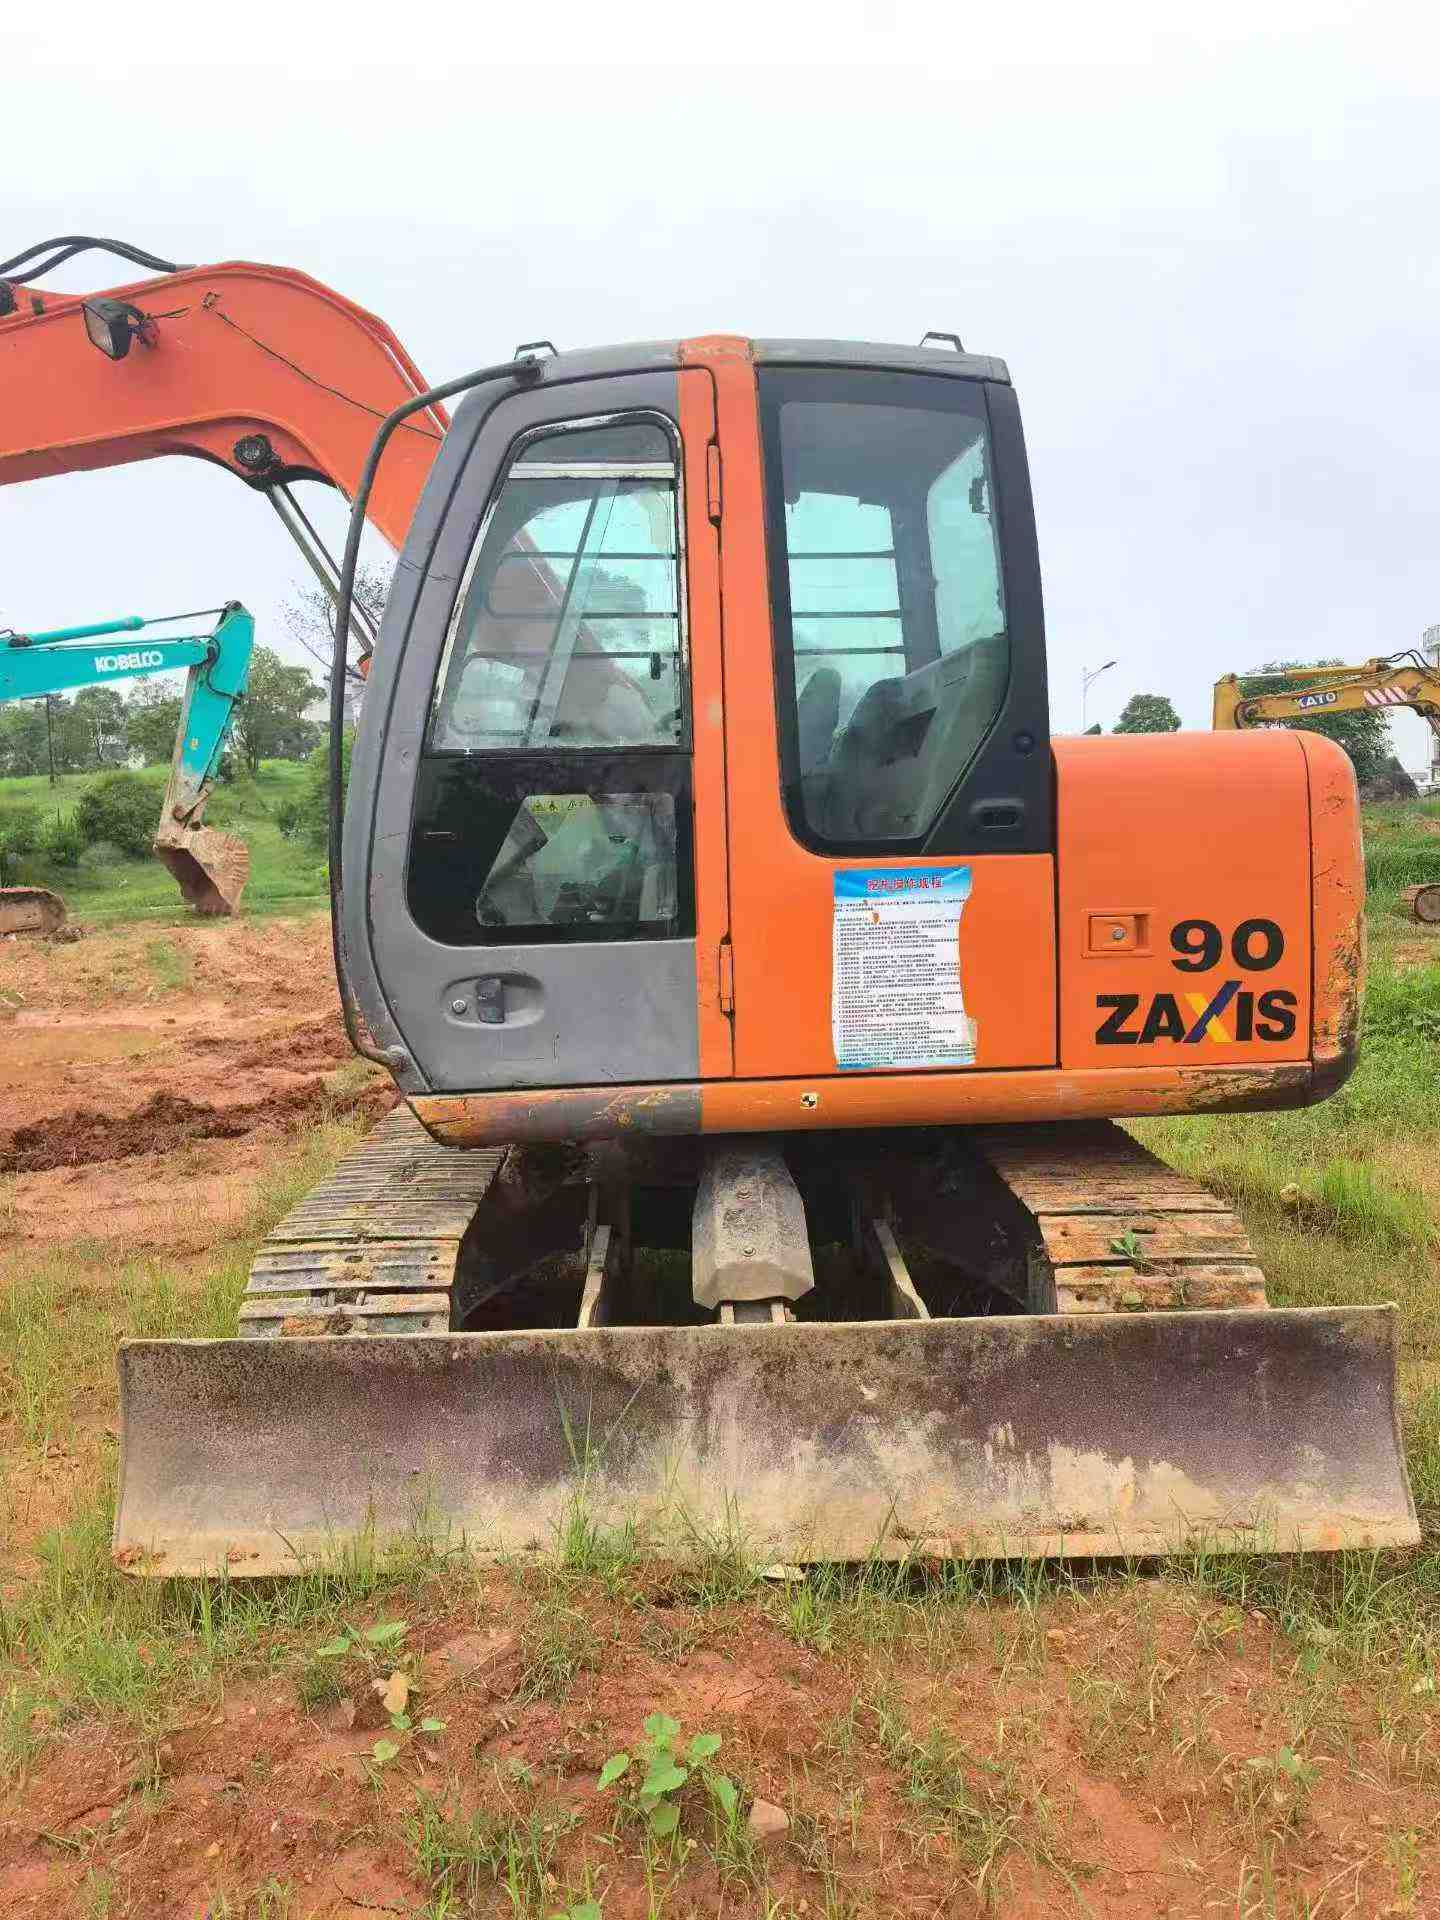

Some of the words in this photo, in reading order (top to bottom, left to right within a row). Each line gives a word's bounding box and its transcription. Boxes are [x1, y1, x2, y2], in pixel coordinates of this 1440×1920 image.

[94, 650, 163, 673] KOBELCO
[1297, 692, 1336, 708] KATO
[1170, 918, 1284, 973] 90
[1095, 980, 1298, 1045] ZAXIS
